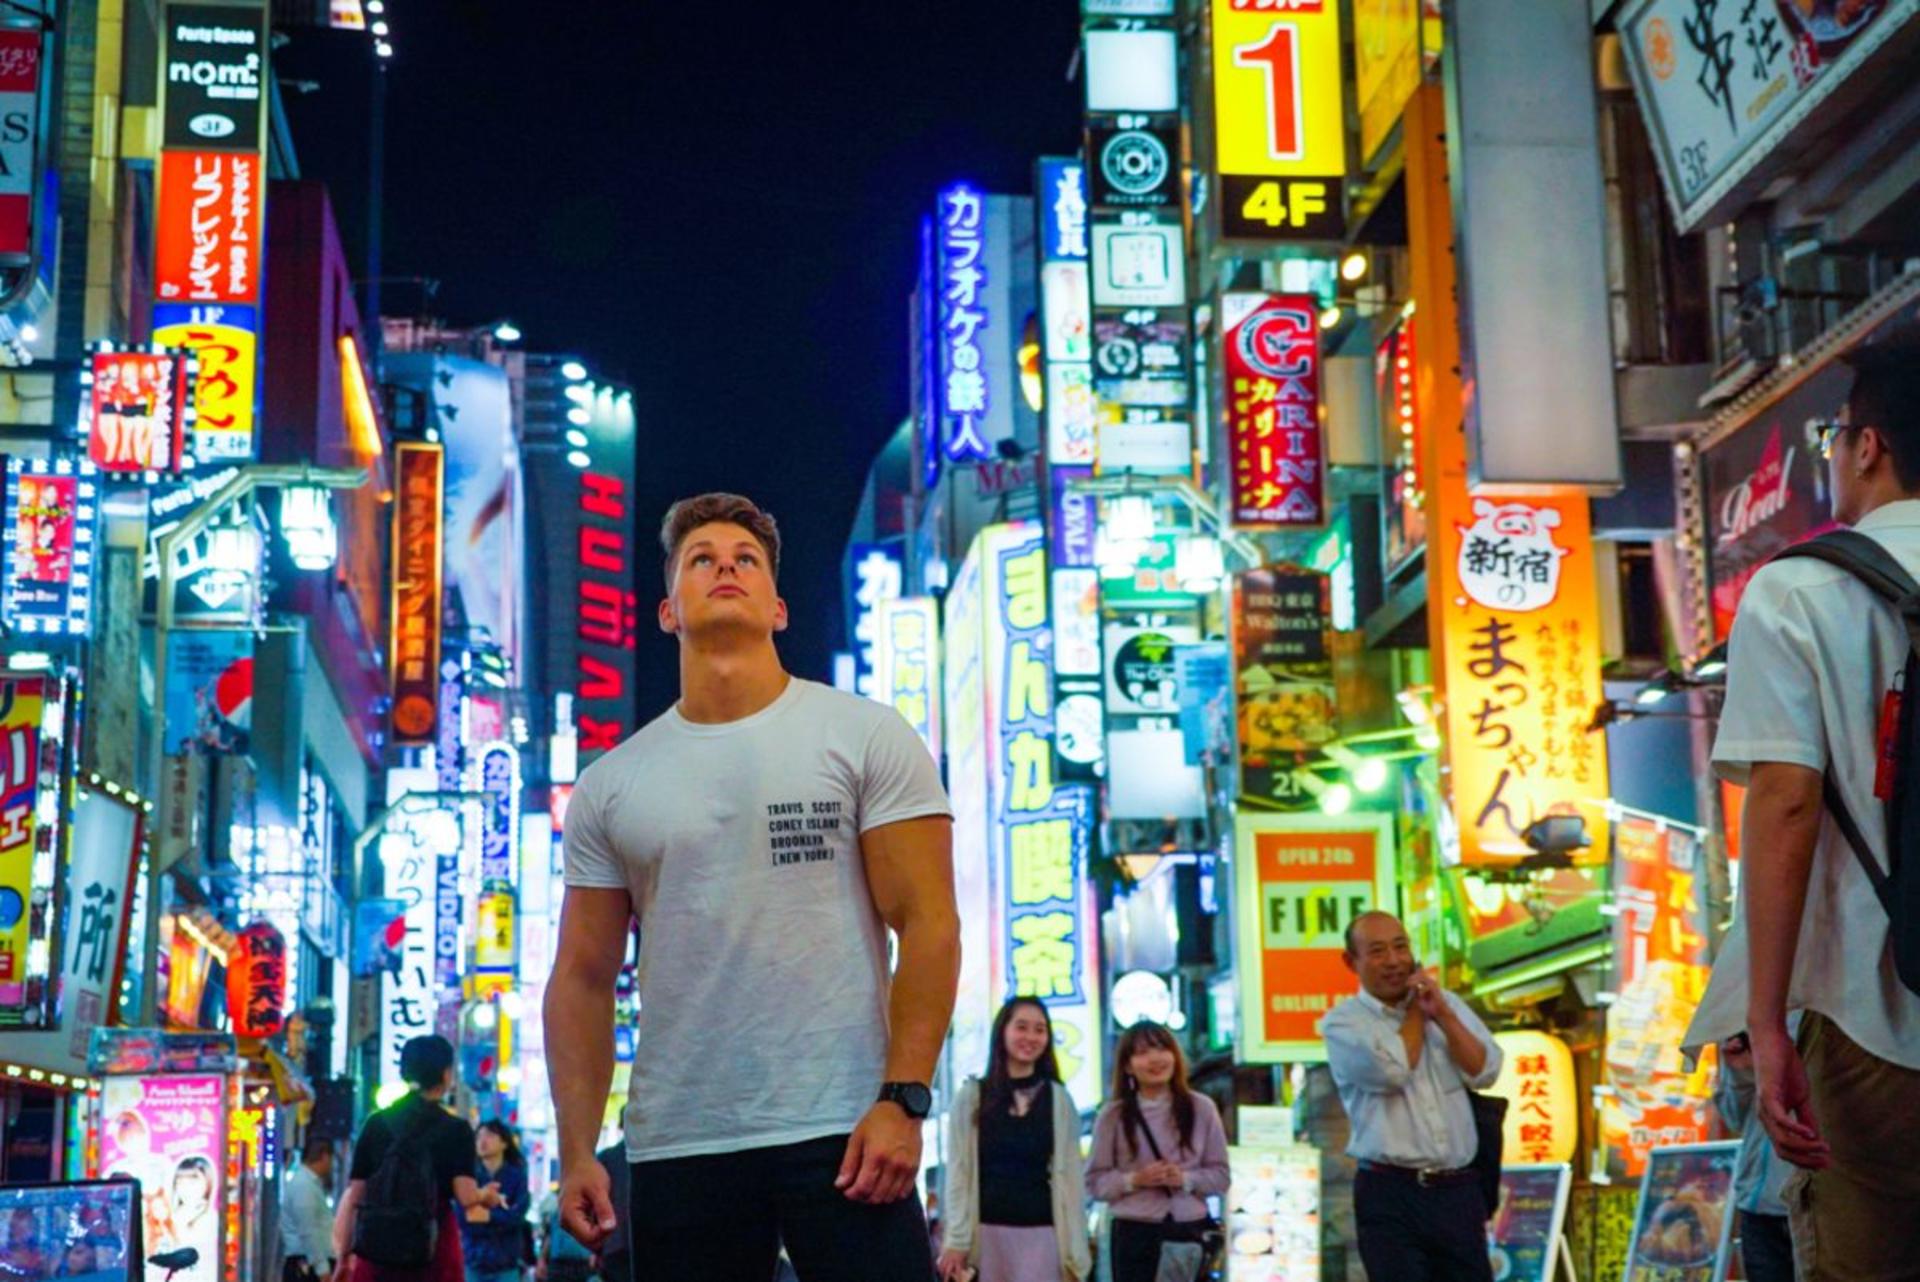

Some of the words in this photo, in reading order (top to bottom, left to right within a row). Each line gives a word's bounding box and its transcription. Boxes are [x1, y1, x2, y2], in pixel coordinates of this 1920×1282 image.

[1233, 22, 1305, 161] 1
[1680, 139, 1709, 191] 3F
[1242, 182, 1326, 227] 4F
[1250, 376, 1284, 510] カリーナ
[1464, 535, 1552, 584] 新宿
[1499, 583, 1527, 606] の
[1467, 616, 1537, 837] まっちゃん
[767, 802, 804, 816] TRAVIS
[811, 801, 842, 814] SCOTT
[768, 818, 803, 832] CONEY
[770, 834, 824, 849] BROOKLYN
[1514, 1054, 1554, 1163] 鉄なべ餃子
